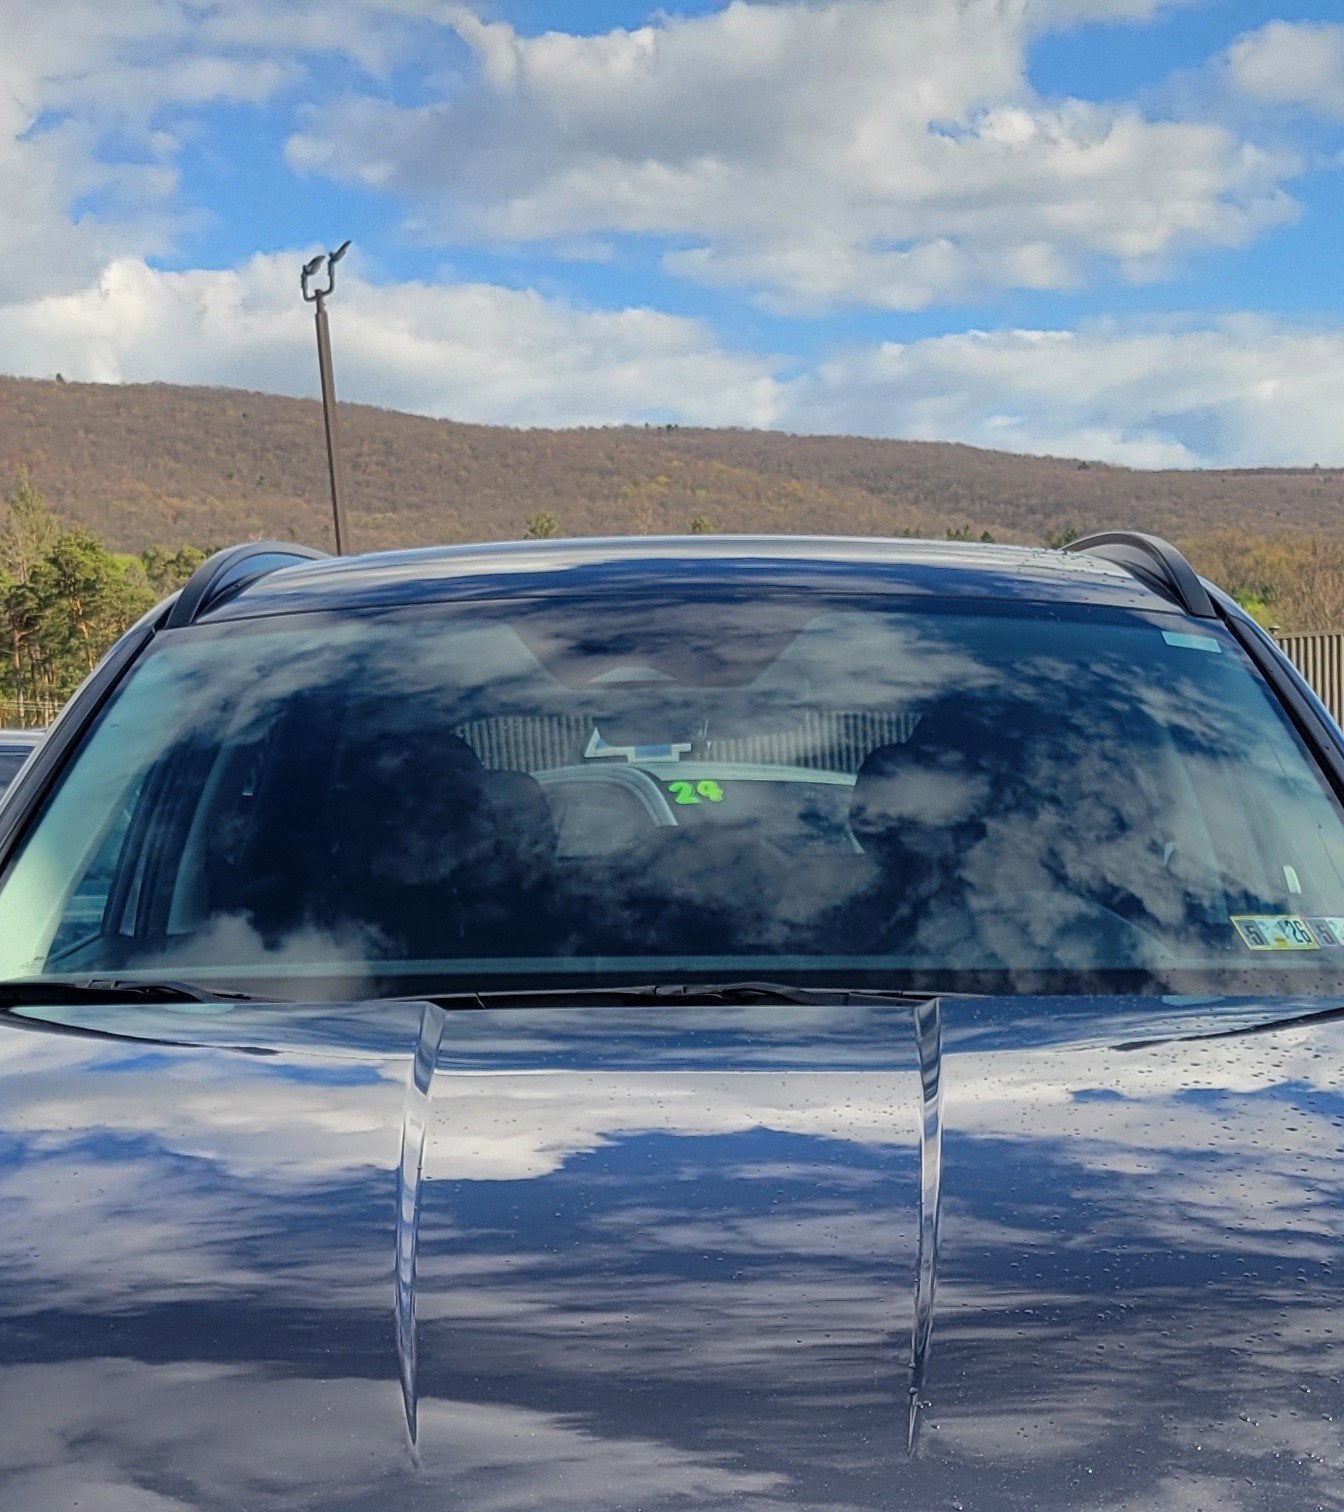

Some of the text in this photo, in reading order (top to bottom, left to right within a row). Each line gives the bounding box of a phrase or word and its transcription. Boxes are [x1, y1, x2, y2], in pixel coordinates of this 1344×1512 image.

[1244, 920, 1312, 946] 5 26
[1315, 924, 1336, 945] 5
